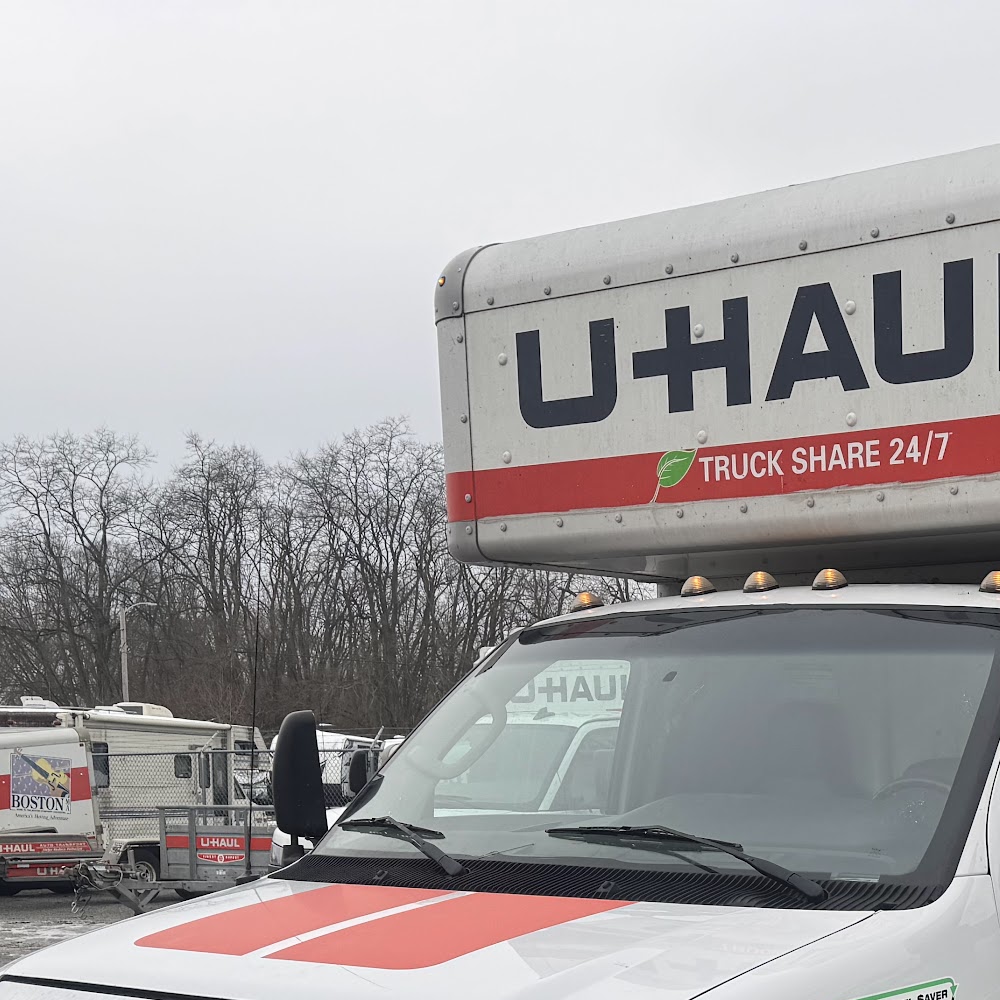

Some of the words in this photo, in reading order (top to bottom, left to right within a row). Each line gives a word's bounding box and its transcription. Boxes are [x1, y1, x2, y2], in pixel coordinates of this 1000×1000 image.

[698, 449, 784, 483] TRUCK
[791, 439, 881, 475] SHARE
[888, 430, 950, 467] 24/7
[12, 795, 64, 812] BOSTON
[201, 838, 240, 848] U-HAUL
